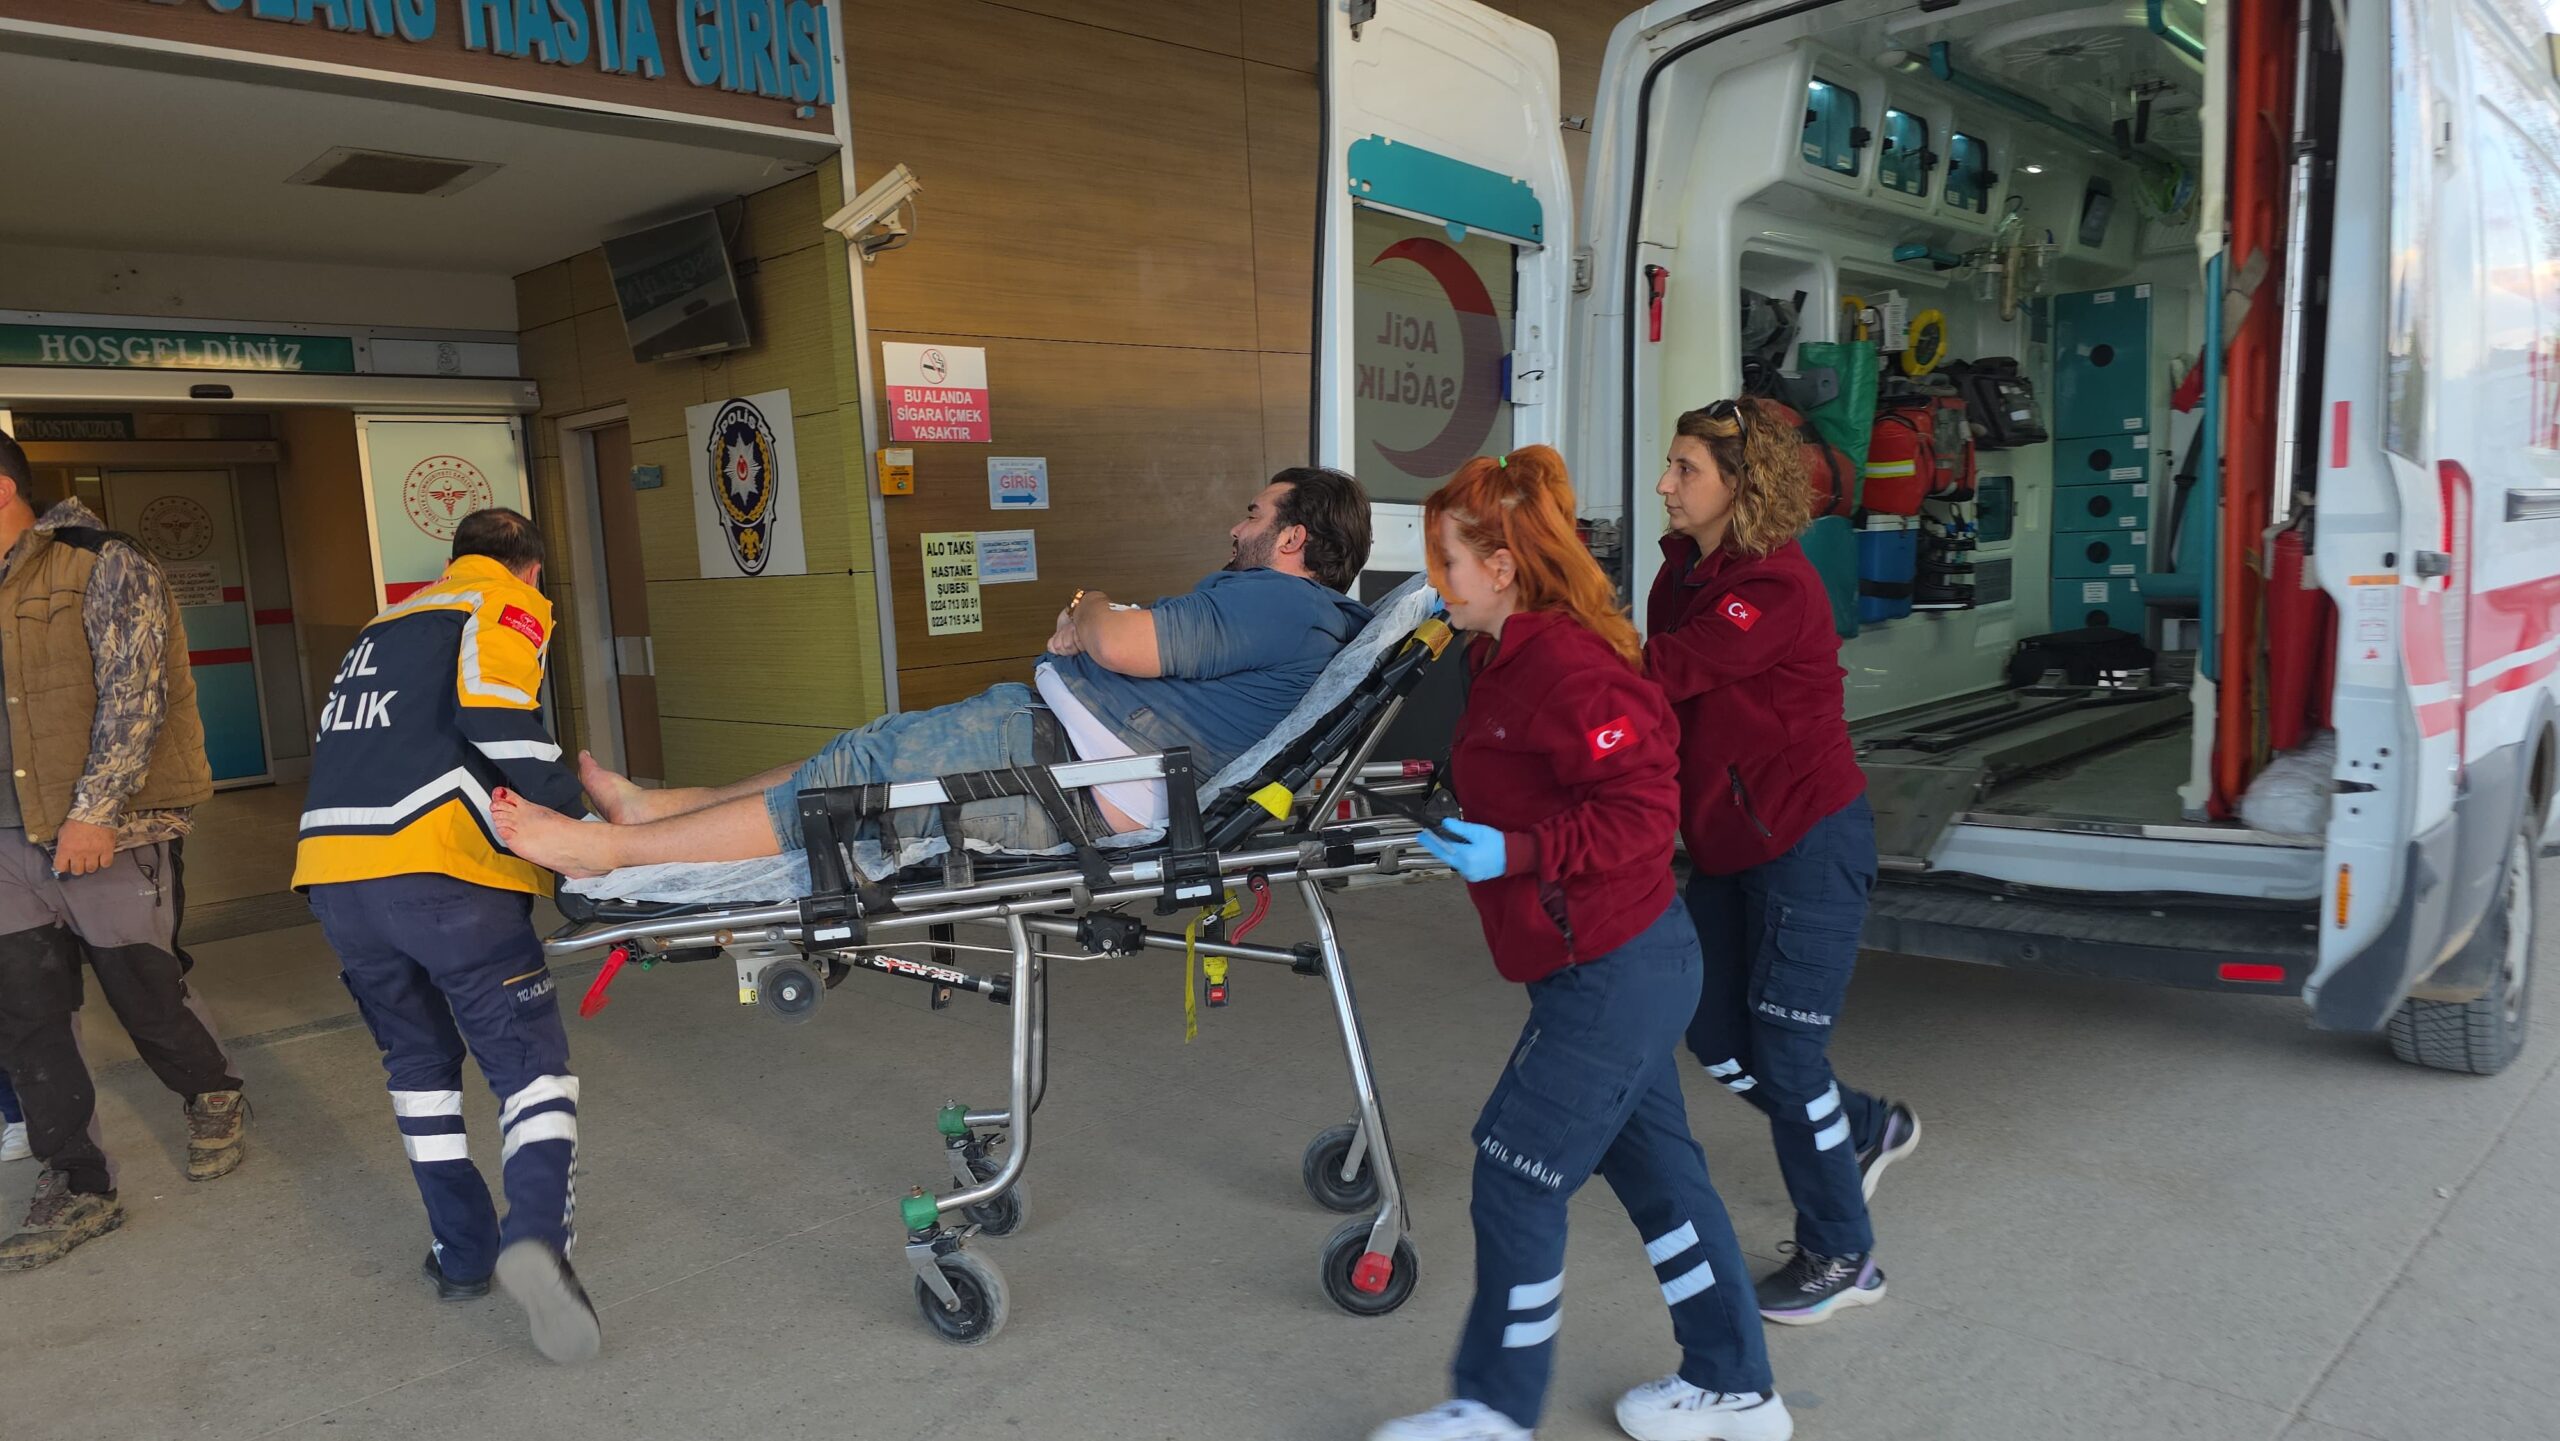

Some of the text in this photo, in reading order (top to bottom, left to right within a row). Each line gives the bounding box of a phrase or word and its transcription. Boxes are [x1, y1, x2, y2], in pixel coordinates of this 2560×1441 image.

[38, 334, 303, 369] HOŞGELDİNİZ
[904, 389, 973, 404] BU ALANDA
[721, 409, 757, 434] POLİS
[897, 404, 982, 425] SİGARA İÇMEK
[912, 426, 971, 440] YASAKTIR
[1000, 472, 1037, 492] GİRİŞ
[926, 542, 945, 556] ALO
[931, 565, 973, 578] HASTANE
[334, 636, 378, 684] CİL
[873, 954, 965, 985] SPENCER
